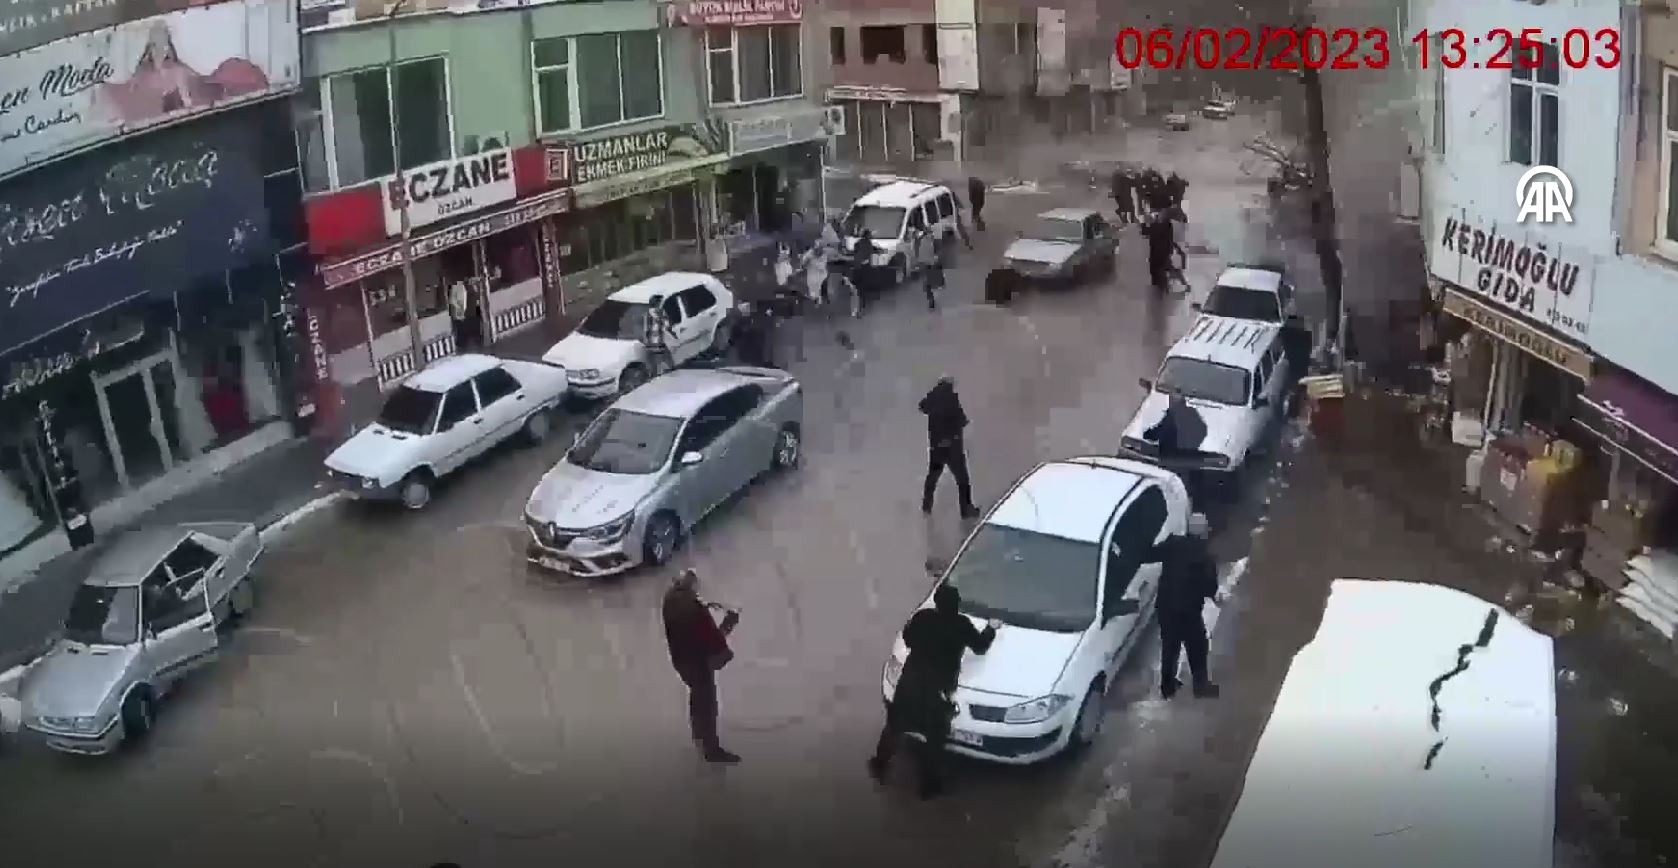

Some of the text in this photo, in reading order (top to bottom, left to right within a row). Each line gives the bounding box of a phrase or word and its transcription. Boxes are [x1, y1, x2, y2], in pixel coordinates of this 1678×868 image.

[40, 56, 115, 101] Moda
[573, 131, 668, 163] UZMANLAR
[387, 152, 511, 212] ECZANE
[577, 159, 626, 183] EKMEK
[1477, 266, 1537, 313] GIDA
